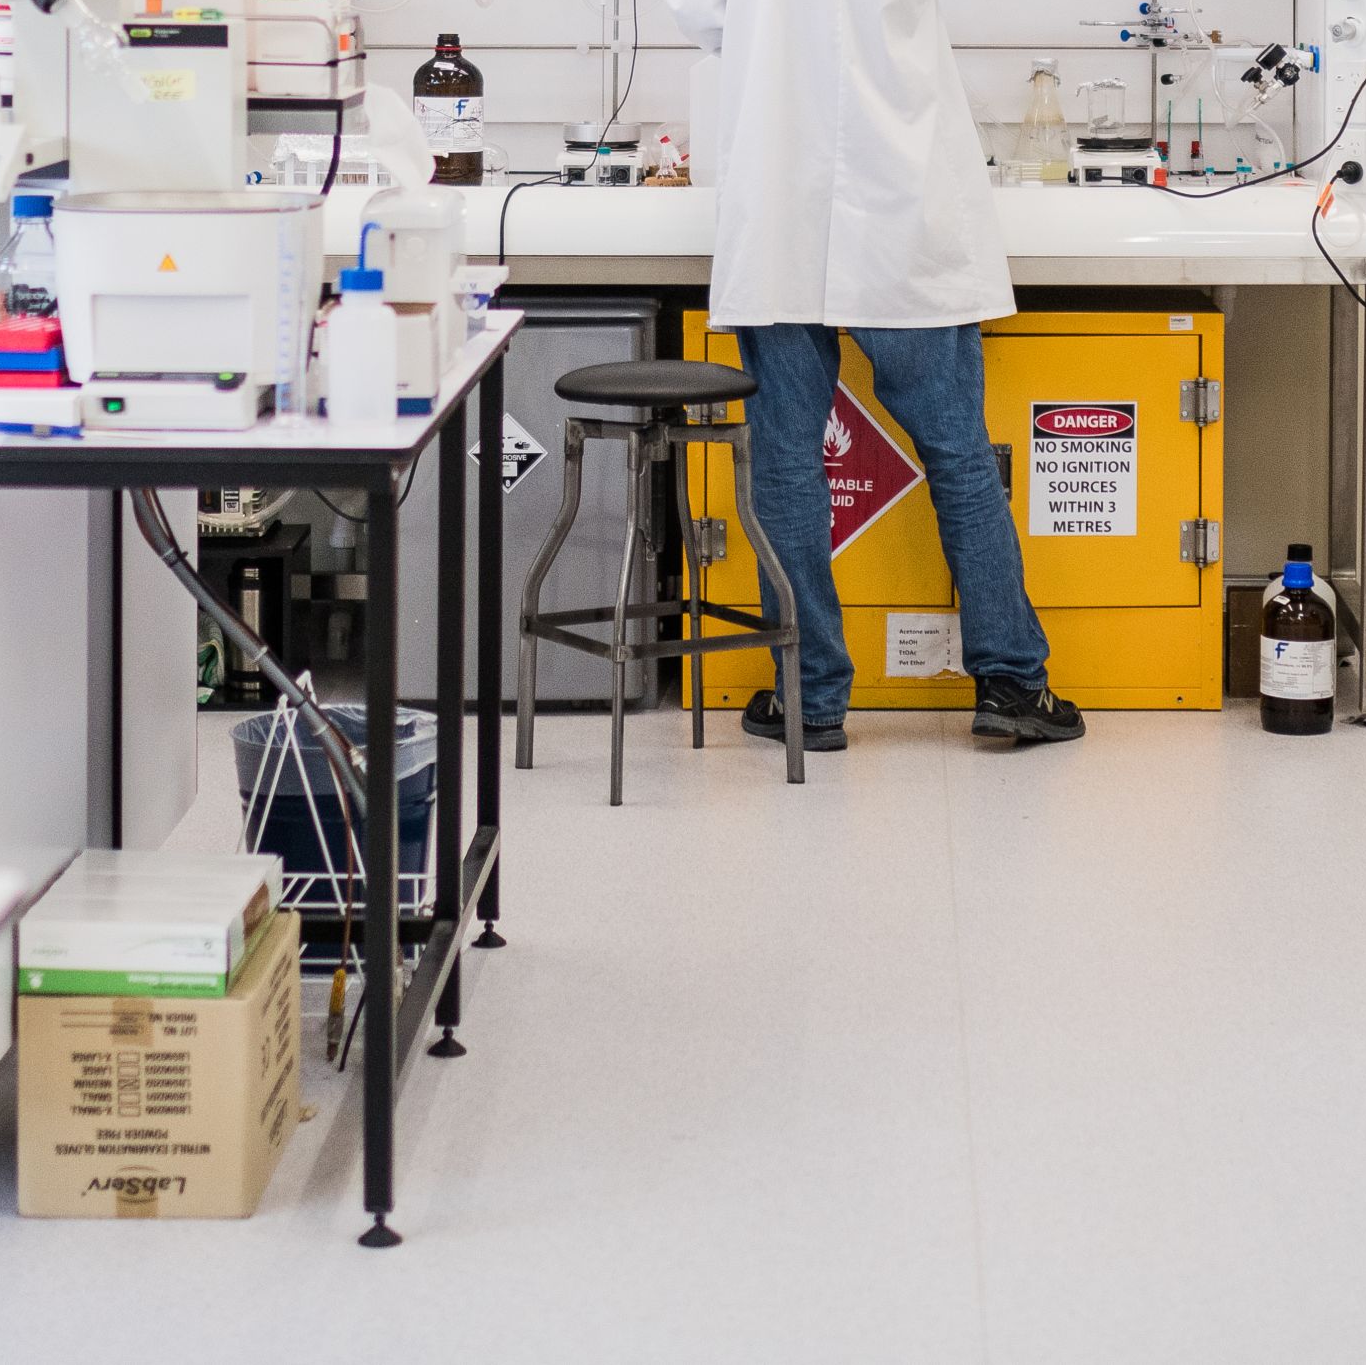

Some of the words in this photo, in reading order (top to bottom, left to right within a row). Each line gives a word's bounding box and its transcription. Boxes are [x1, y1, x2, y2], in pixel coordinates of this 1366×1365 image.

[1053, 415, 1118, 429] DANGER
[1034, 441, 1057, 453] NO
[1061, 441, 1132, 453] SMOKING
[1035, 461, 1058, 473] NO
[1062, 461, 1130, 473] IGNITION
[828, 478, 873, 492] MABLE
[1048, 481, 1117, 493] SOURCES
[1048, 501, 1104, 513] WITHIN
[1108, 501, 1116, 513] 3
[1053, 521, 1112, 533] METRES
[95, 1128, 121, 1140] FREE
[124, 1128, 169, 1140] POWDER
[55, 1144, 95, 1155] GLOVES
[97, 1143, 169, 1155] EXAMINATION
[170, 1143, 211, 1155] NITRILE
[86, 1176, 187, 1198] LabServ
